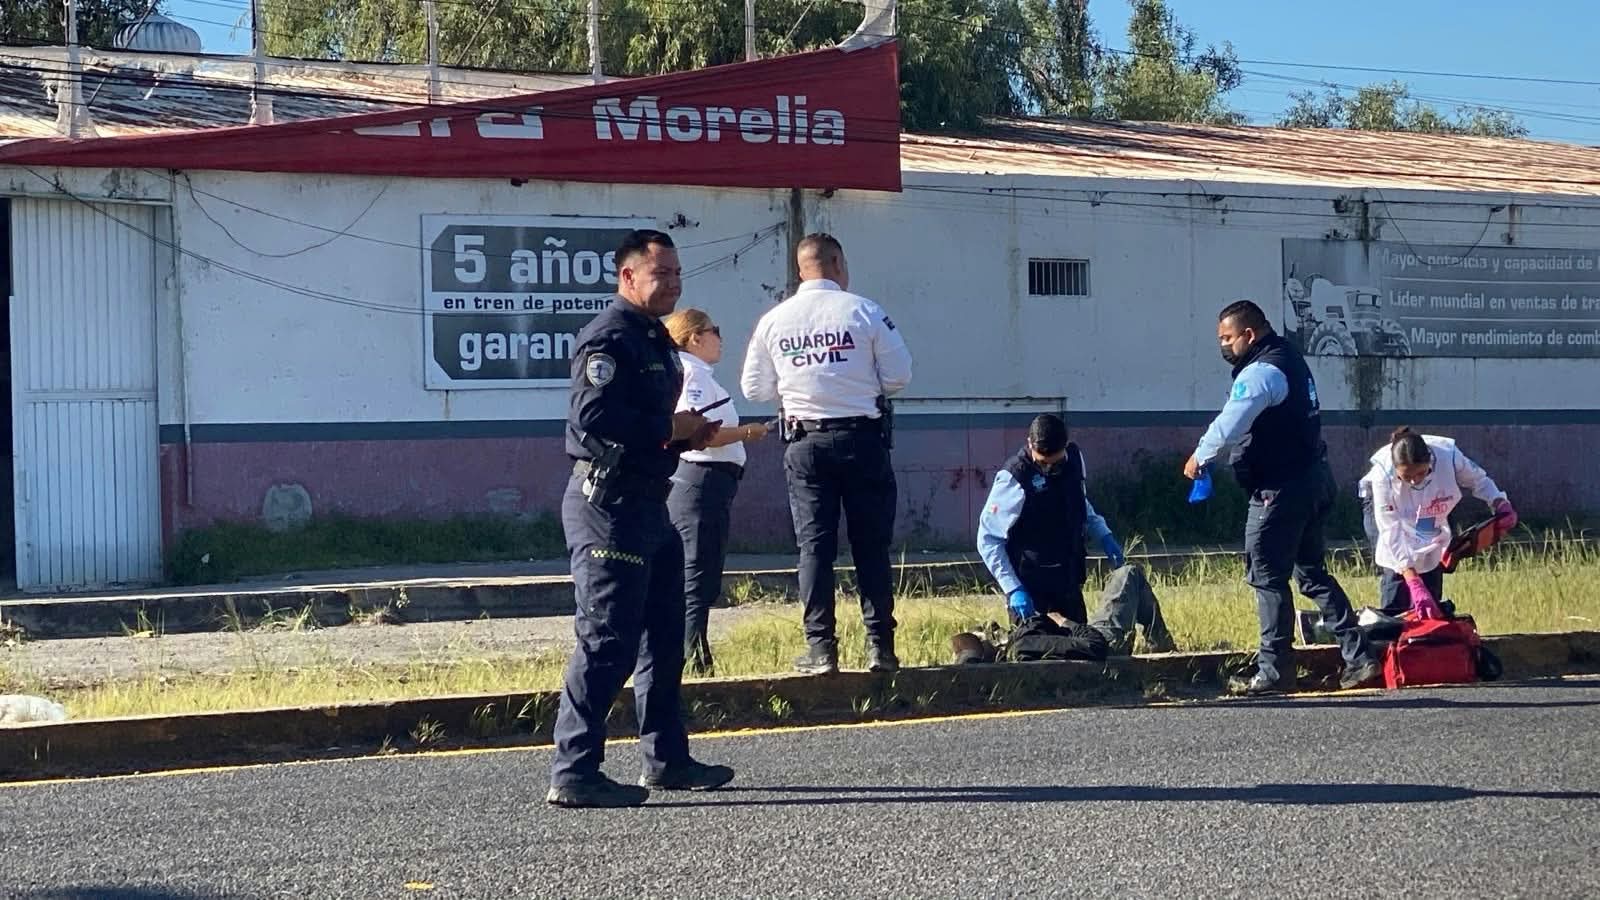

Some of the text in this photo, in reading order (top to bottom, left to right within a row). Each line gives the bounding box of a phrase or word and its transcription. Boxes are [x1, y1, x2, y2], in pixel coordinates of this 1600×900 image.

[592, 95, 845, 145] Morelia
[454, 234, 487, 284] 5
[1492, 257, 1500, 273] y
[1504, 254, 1572, 274] capacidad
[1576, 255, 1593, 270] de
[443, 299, 465, 310] en
[474, 296, 514, 310] tren
[523, 295, 544, 310] de
[1430, 292, 1485, 309] mundial
[1489, 297, 1506, 309] en
[1510, 296, 1557, 311] ventas
[1561, 293, 1578, 310] de
[779, 330, 854, 352] GUARDIA
[1411, 327, 1457, 348] Mayor
[1461, 329, 1543, 345] rendimiento
[1547, 329, 1563, 345] de
[459, 327, 583, 372] garan
[791, 351, 848, 368] CIVIL
